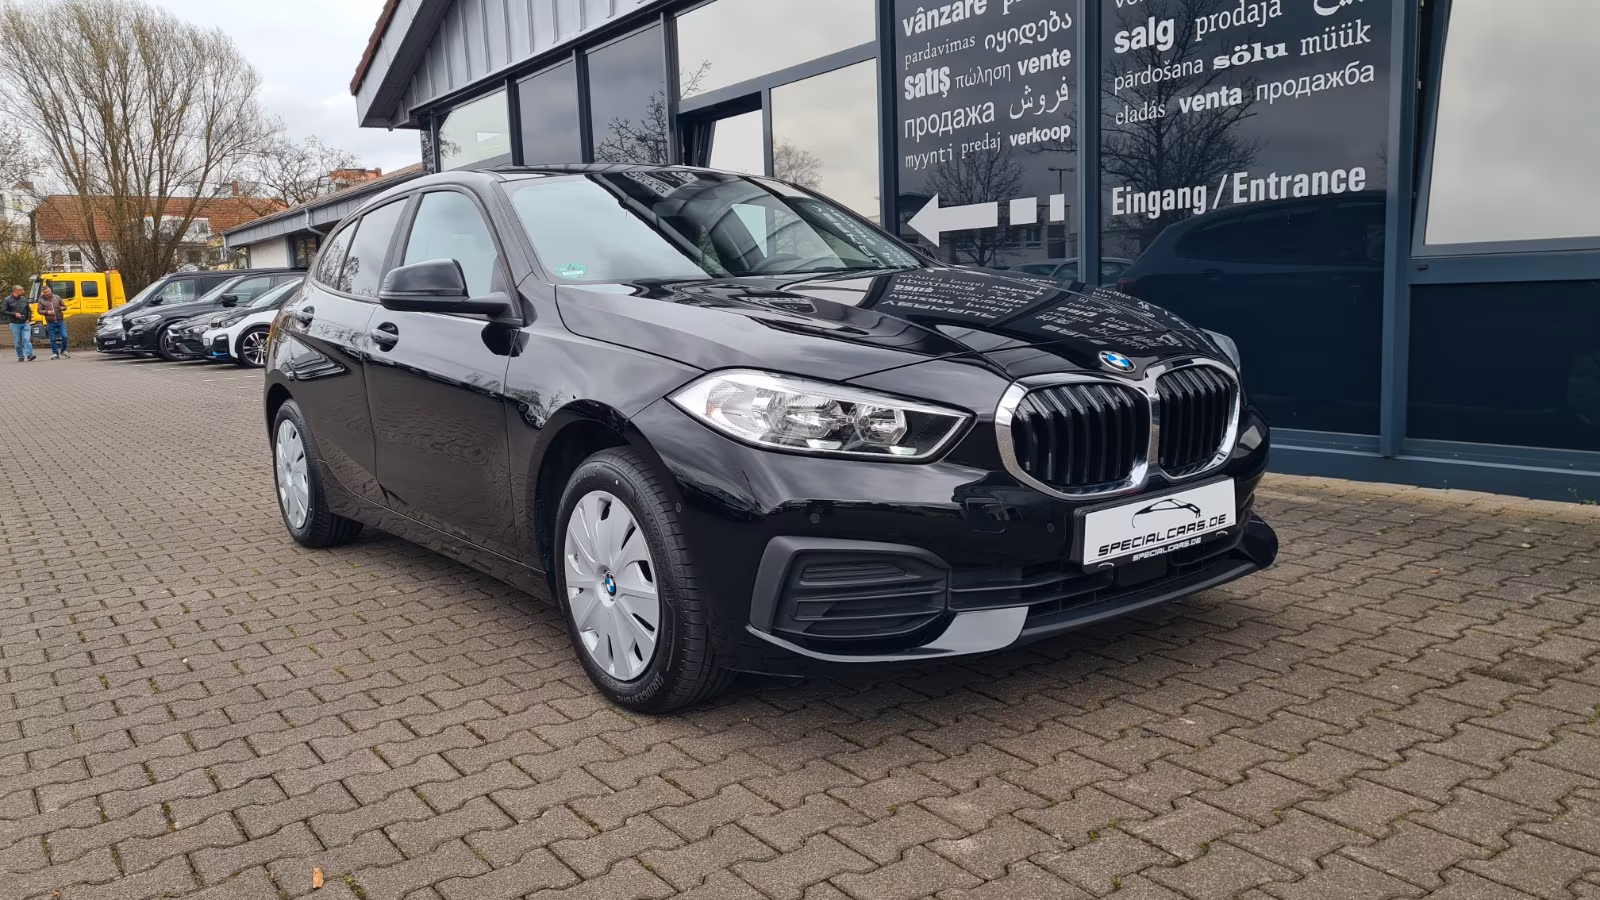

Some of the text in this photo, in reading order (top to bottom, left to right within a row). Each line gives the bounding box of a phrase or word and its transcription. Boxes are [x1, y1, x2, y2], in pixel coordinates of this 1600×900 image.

[903, 0, 988, 36] vânzare
[985, 10, 1072, 52] იყიდება
[1114, 16, 1175, 54] salg
[1195, 0, 1282, 41] prodaja
[905, 36, 976, 70] pardavimas
[1300, 19, 1371, 56] müük
[1017, 48, 1071, 76] vente
[1213, 42, 1289, 70] sölu
[904, 66, 950, 100] satış
[955, 63, 1011, 89] πώληση
[1114, 58, 1204, 95] pārdošana
[1256, 61, 1375, 104] продажба
[1009, 76, 1069, 119] فروش
[1115, 100, 1166, 125] eladás
[1179, 85, 1243, 113] venta
[904, 102, 995, 142] продажа
[1009, 124, 1071, 147] verkoop
[905, 144, 953, 171] myynti
[961, 132, 1001, 159] predaj
[1098, 513, 1226, 556] SPECIALCARS.DE
[1132, 537, 1201, 562] SPECIALCARS.DE
